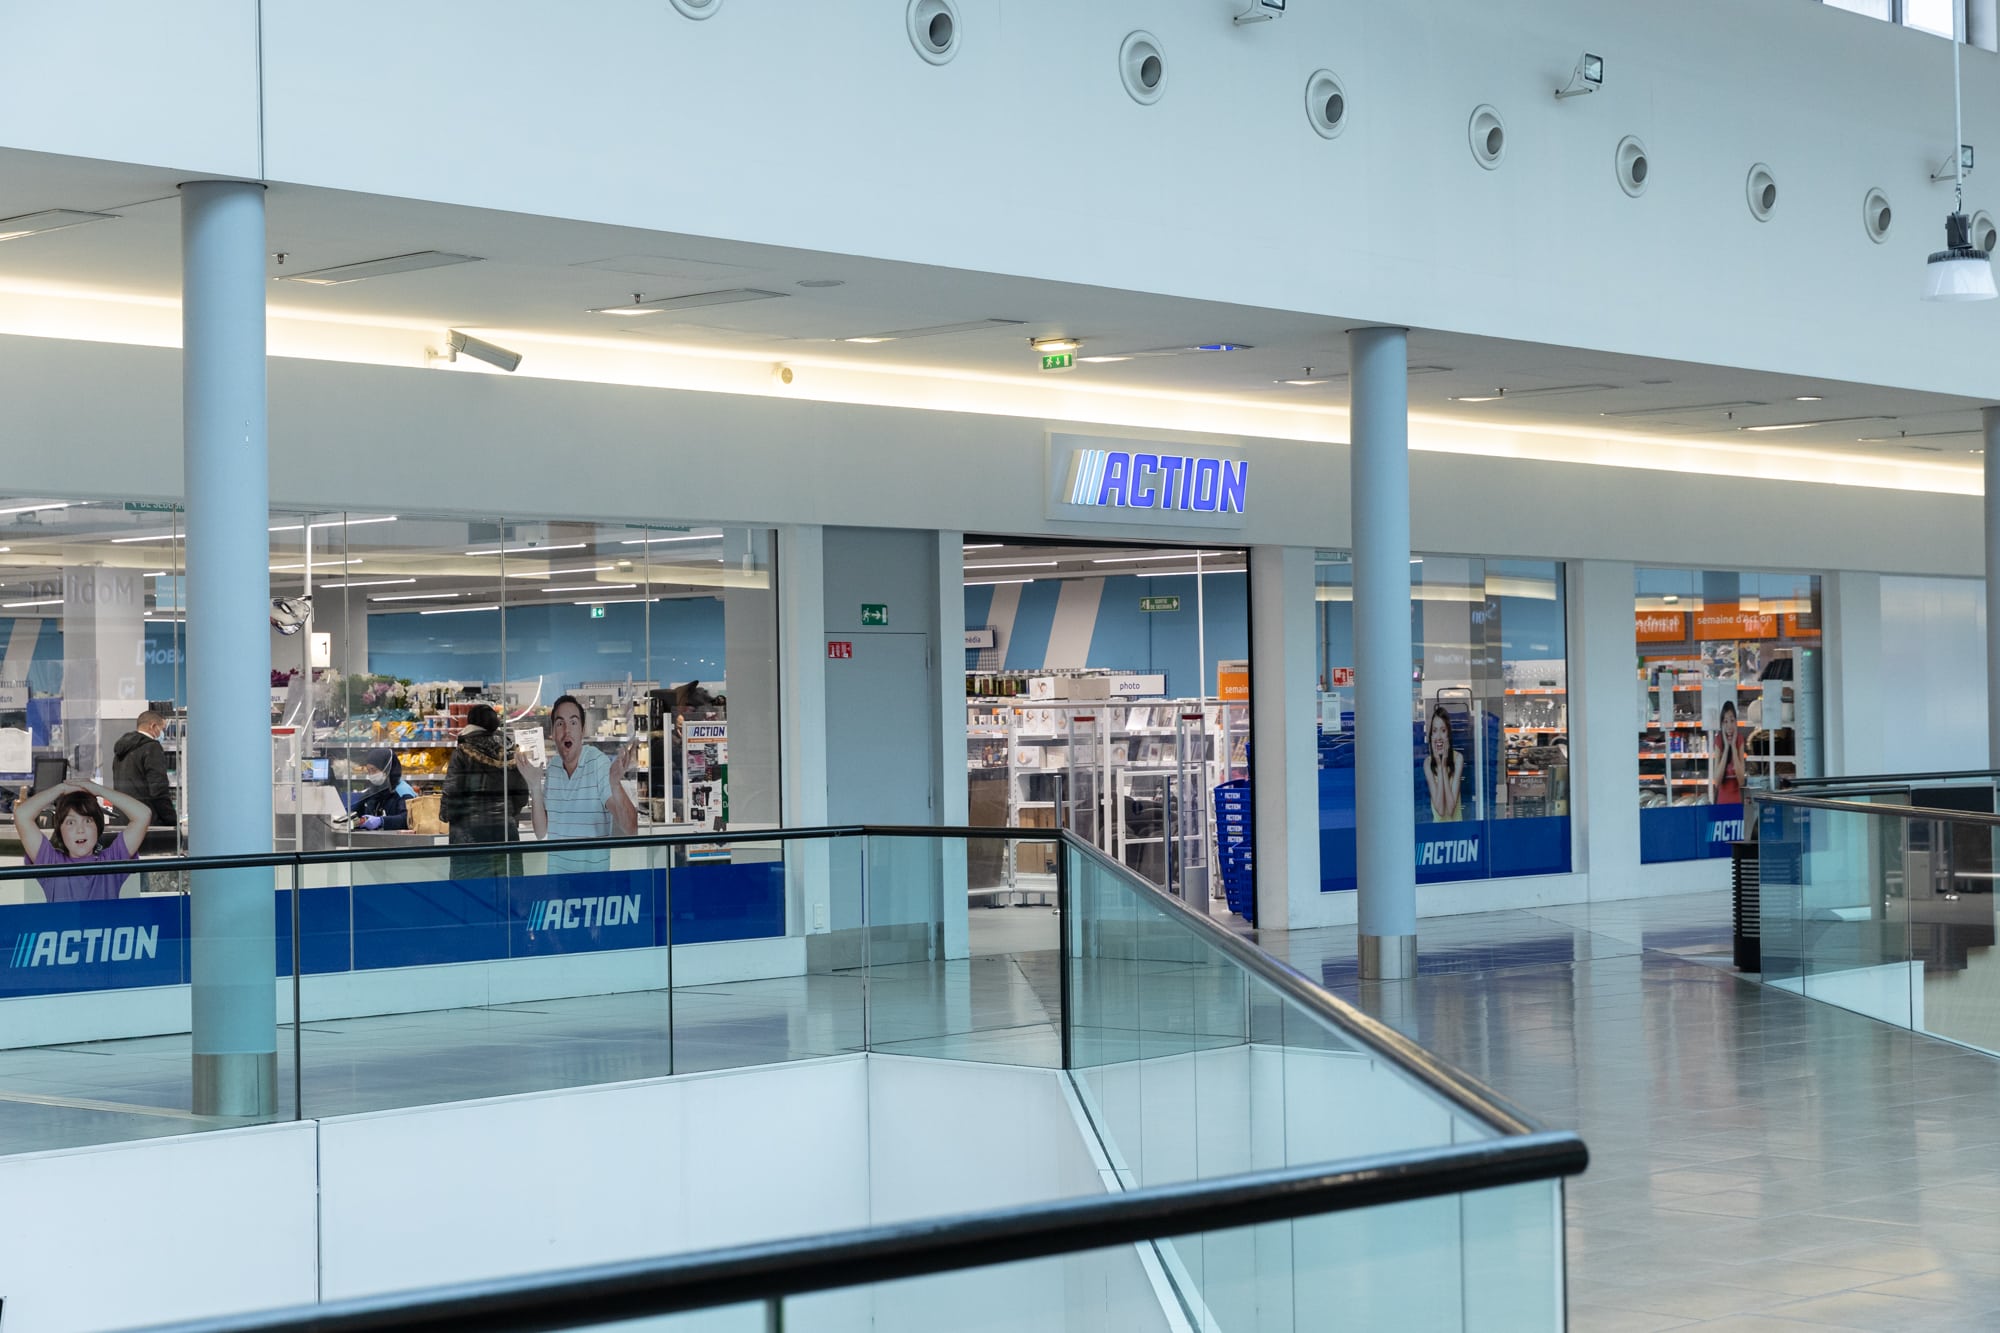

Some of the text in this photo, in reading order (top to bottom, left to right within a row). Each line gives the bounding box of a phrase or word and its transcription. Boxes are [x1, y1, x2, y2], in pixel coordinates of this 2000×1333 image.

[1097, 451, 1248, 513] ACTION
[1736, 613, 1773, 624] d'Acton
[1119, 681, 1141, 692] photo
[1225, 684, 1249, 694] semain
[693, 726, 725, 737] ACTION
[1713, 820, 1745, 842] ACTI
[1421, 839, 1479, 865] ACTION
[542, 894, 641, 930] ACTION
[31, 925, 159, 967] ACTION
